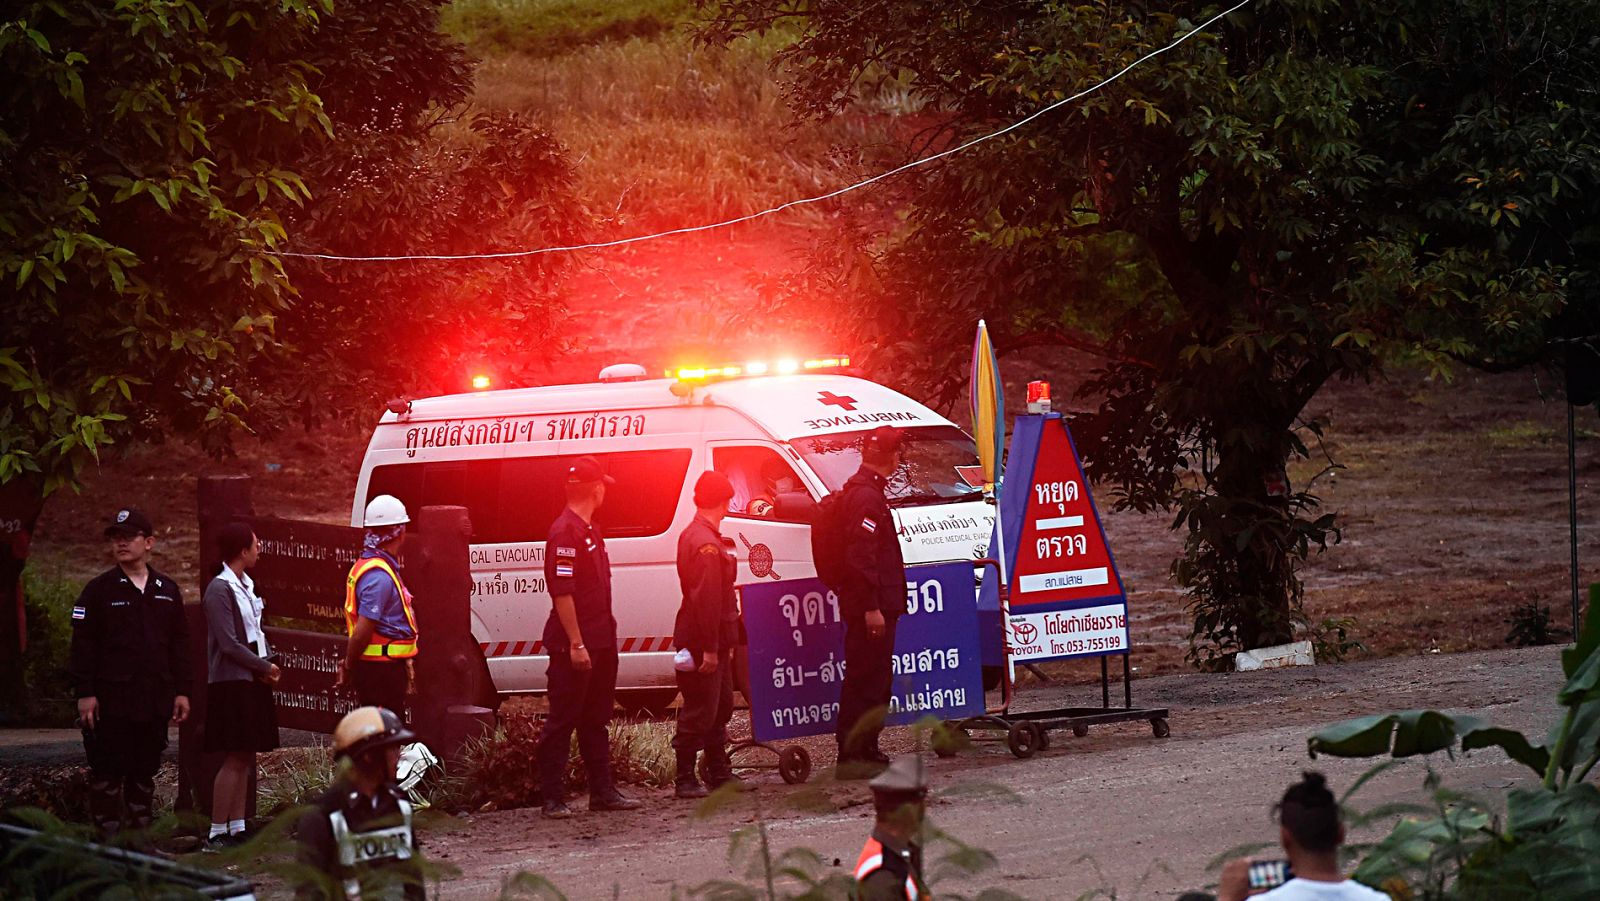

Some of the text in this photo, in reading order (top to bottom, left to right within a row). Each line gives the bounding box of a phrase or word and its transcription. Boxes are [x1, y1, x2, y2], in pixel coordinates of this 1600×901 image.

[547, 410, 645, 440] รพ.ตำรวจ
[1035, 480, 1079, 515] หยุด
[921, 537, 945, 545] POLICE
[945, 533, 972, 543] MEDICAL
[1036, 534, 1087, 560] ตรวจ
[485, 573, 508, 595] หรือ
[514, 577, 549, 593] 02-20
